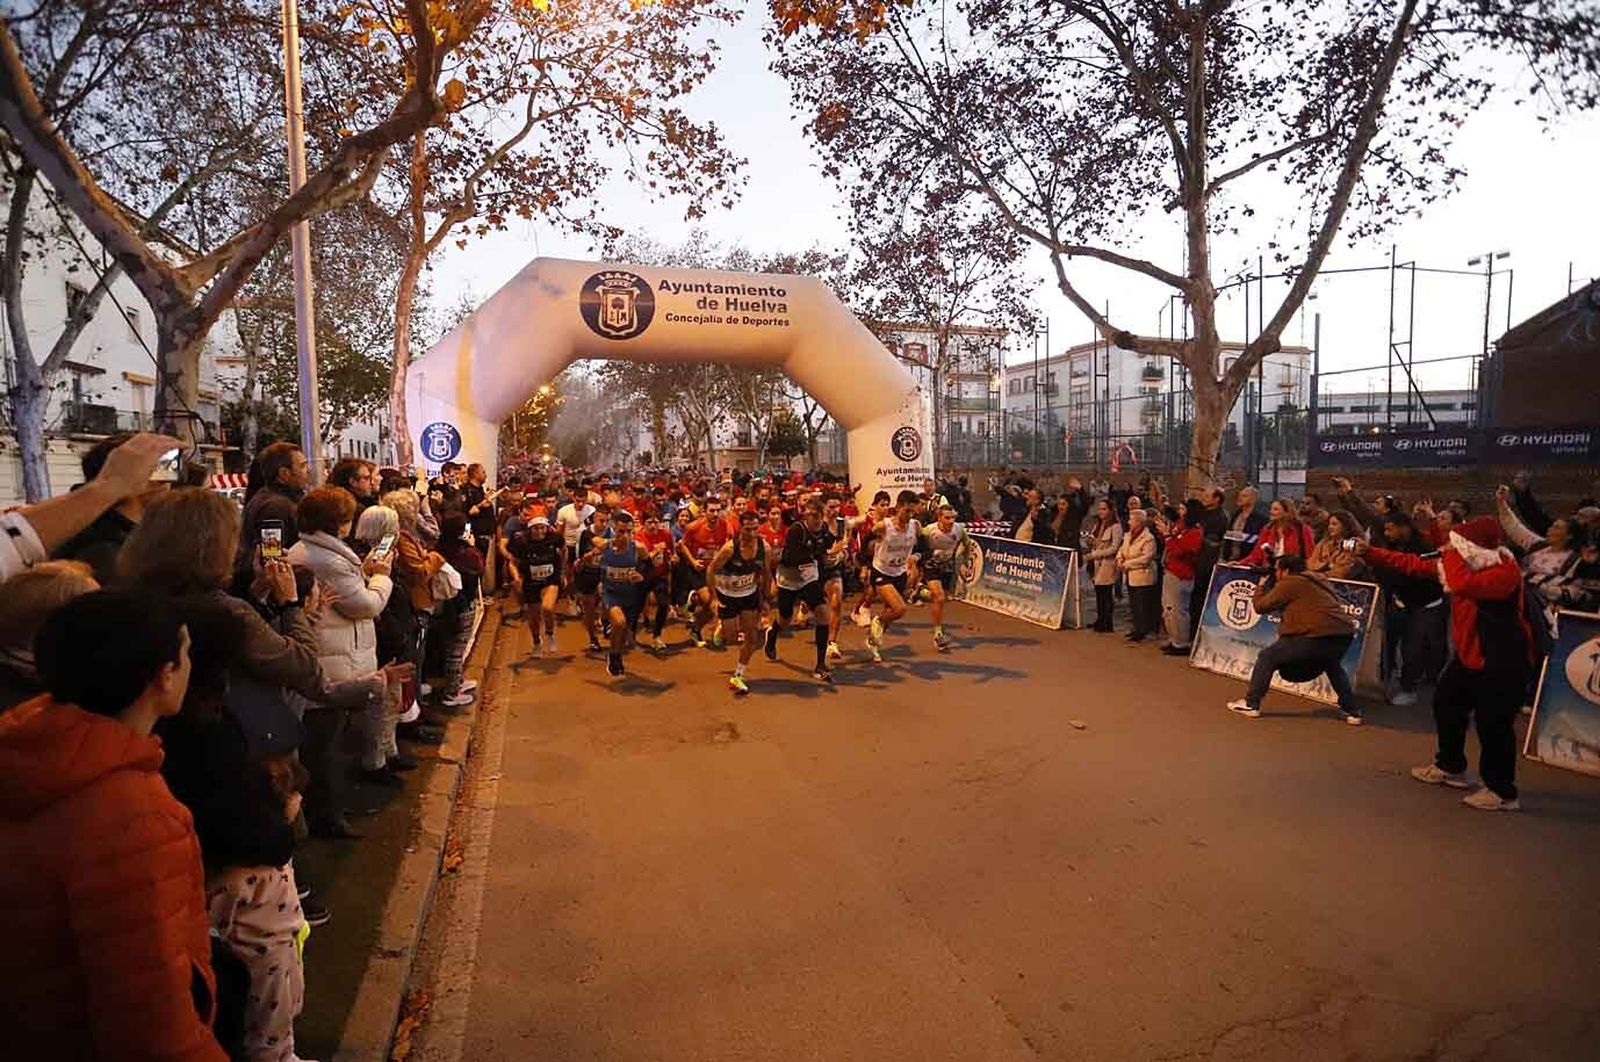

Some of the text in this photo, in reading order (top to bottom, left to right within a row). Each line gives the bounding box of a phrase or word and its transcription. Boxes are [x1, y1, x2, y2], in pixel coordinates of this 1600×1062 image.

[659, 279, 787, 297] Ayuntamiento
[696, 297, 788, 313] de Huelva
[726, 316, 739, 324] de
[742, 316, 790, 327] Deportes
[1414, 438, 1467, 448] HYUNDAI
[1523, 434, 1590, 444] HYUNDAI
[1338, 441, 1382, 451] HYUNDAI
[1009, 565, 1043, 582] Huelva
